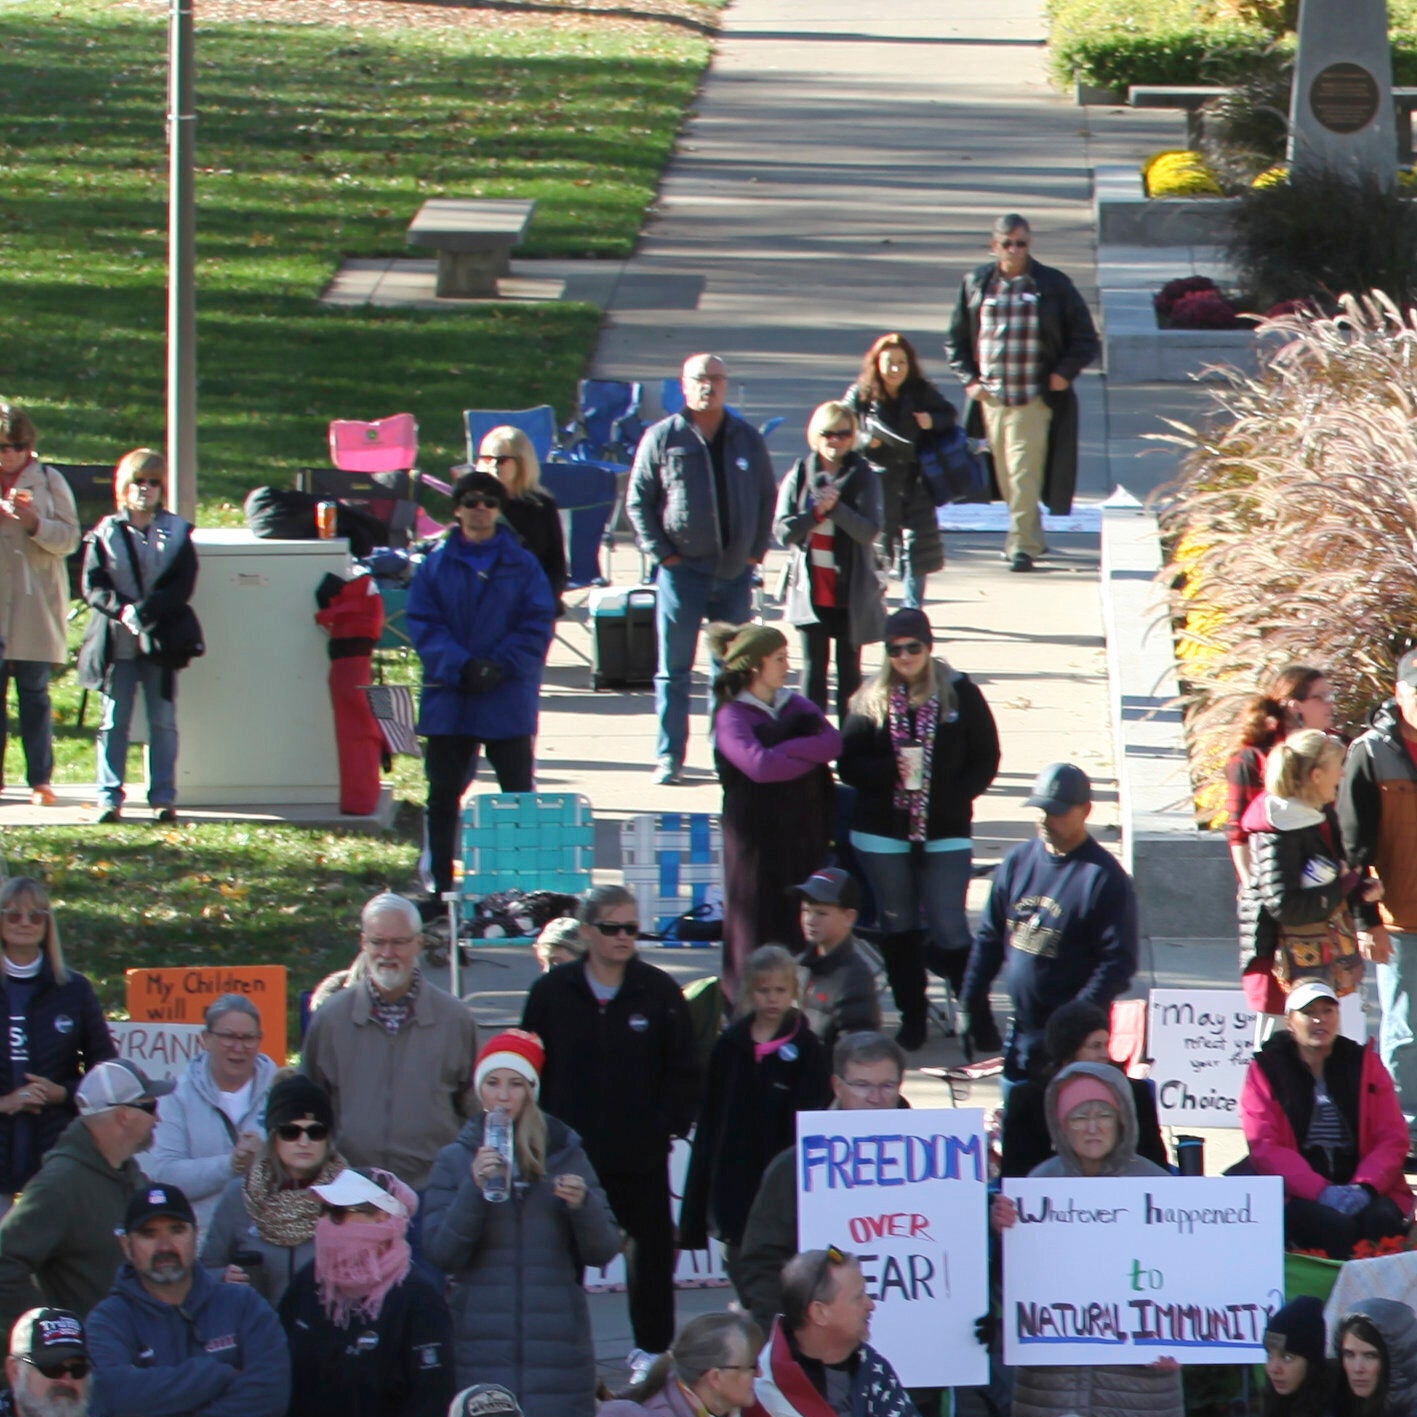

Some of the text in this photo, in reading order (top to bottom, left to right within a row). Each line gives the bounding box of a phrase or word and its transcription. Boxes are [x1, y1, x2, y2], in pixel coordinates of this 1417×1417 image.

[146, 971, 267, 1002] My Children
[802, 1134, 985, 1192] FREEDOM
[849, 1212, 938, 1244] OVER
[1016, 1192, 1259, 1234] Whatever happened
[1126, 1258, 1164, 1291] to
[1016, 1301, 1129, 1340] NATURAL
